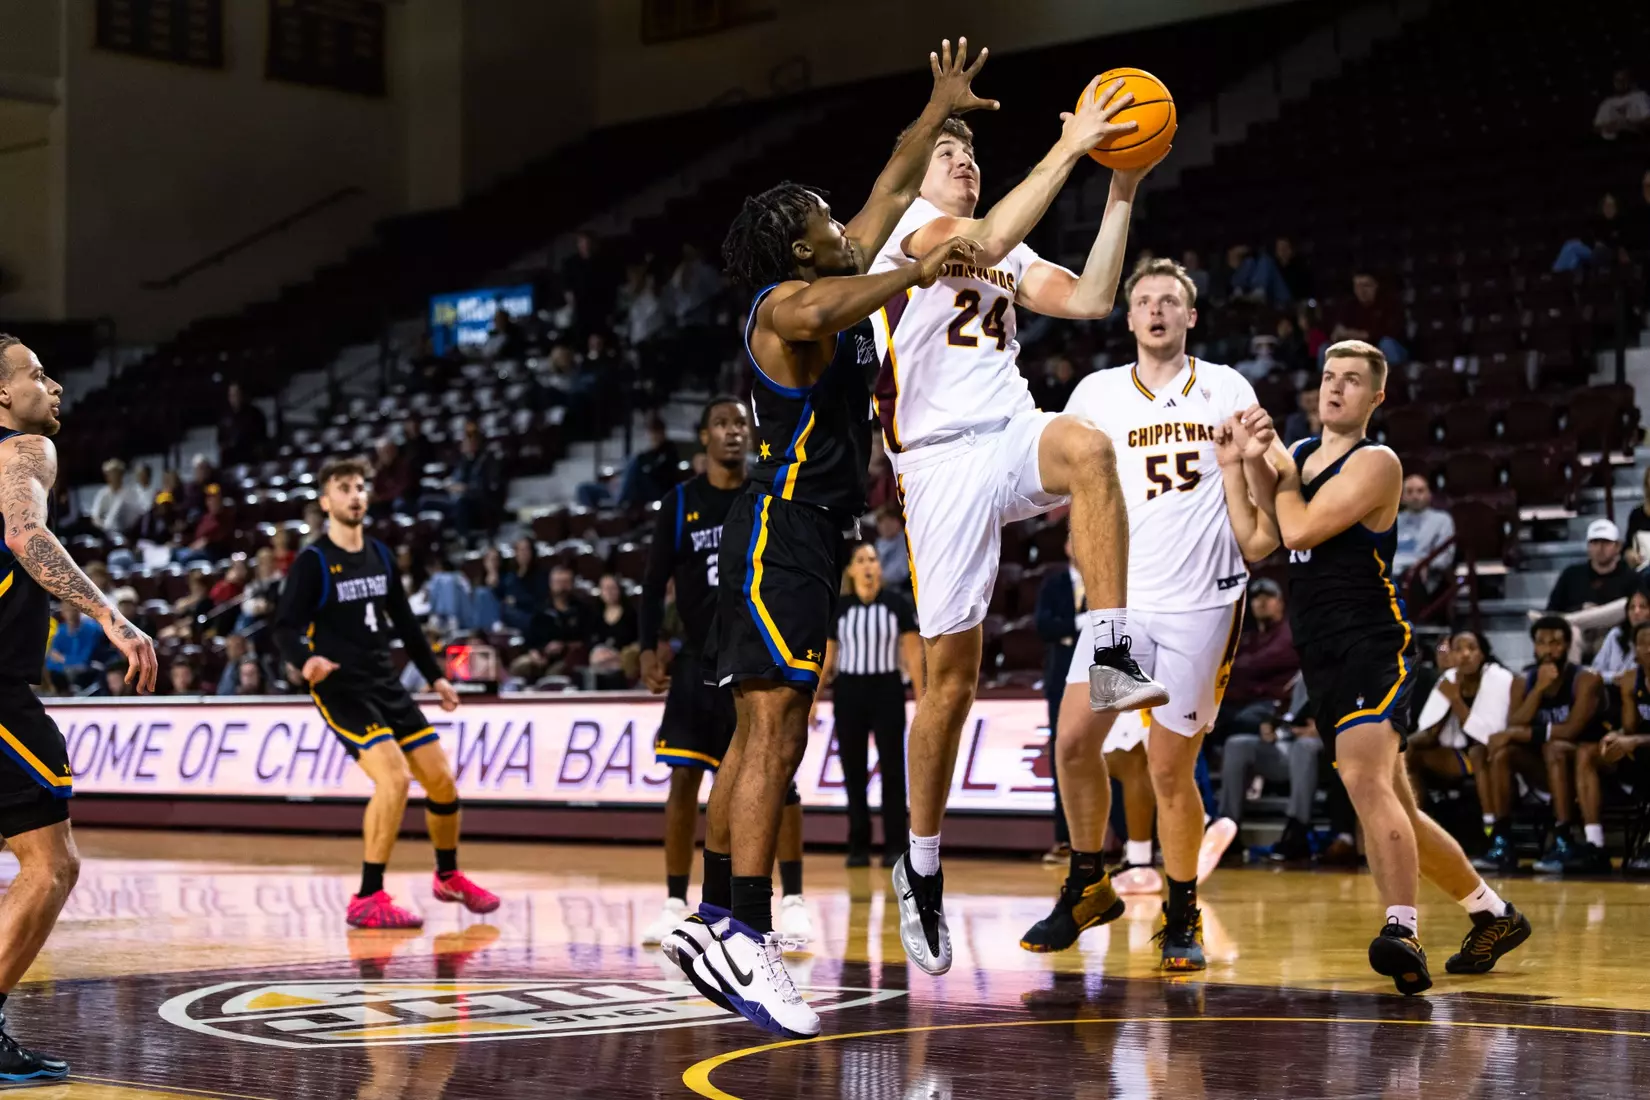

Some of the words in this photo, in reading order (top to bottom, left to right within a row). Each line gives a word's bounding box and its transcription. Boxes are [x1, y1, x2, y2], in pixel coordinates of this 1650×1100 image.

[947, 288, 1010, 352] 24
[1145, 451, 1202, 501] 55
[364, 602, 379, 633] 4
[178, 722, 248, 782] OF
[255, 720, 534, 785] CHIWA
[530, 1006, 677, 1025] 1946
